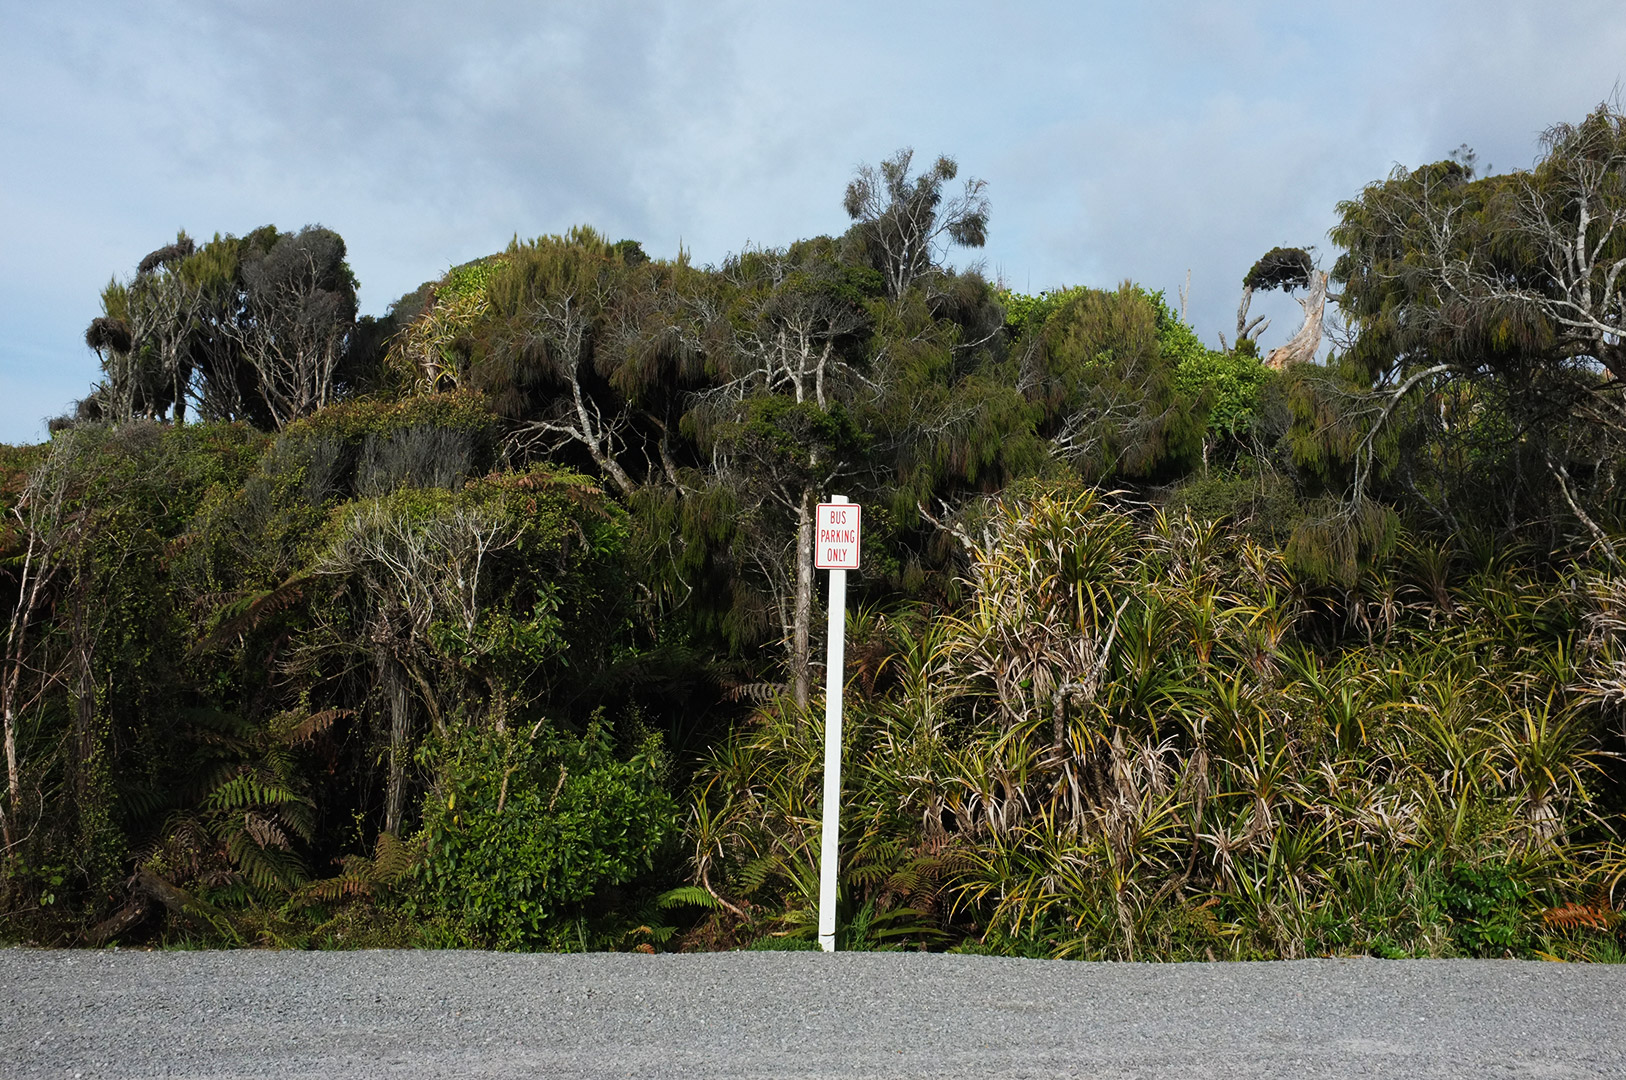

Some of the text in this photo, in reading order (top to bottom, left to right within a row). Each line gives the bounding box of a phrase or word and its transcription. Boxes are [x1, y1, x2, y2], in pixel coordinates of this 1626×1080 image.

[830, 510, 847, 525] BUS
[820, 529, 855, 544] PARKING
[827, 547, 848, 562] ONLY
